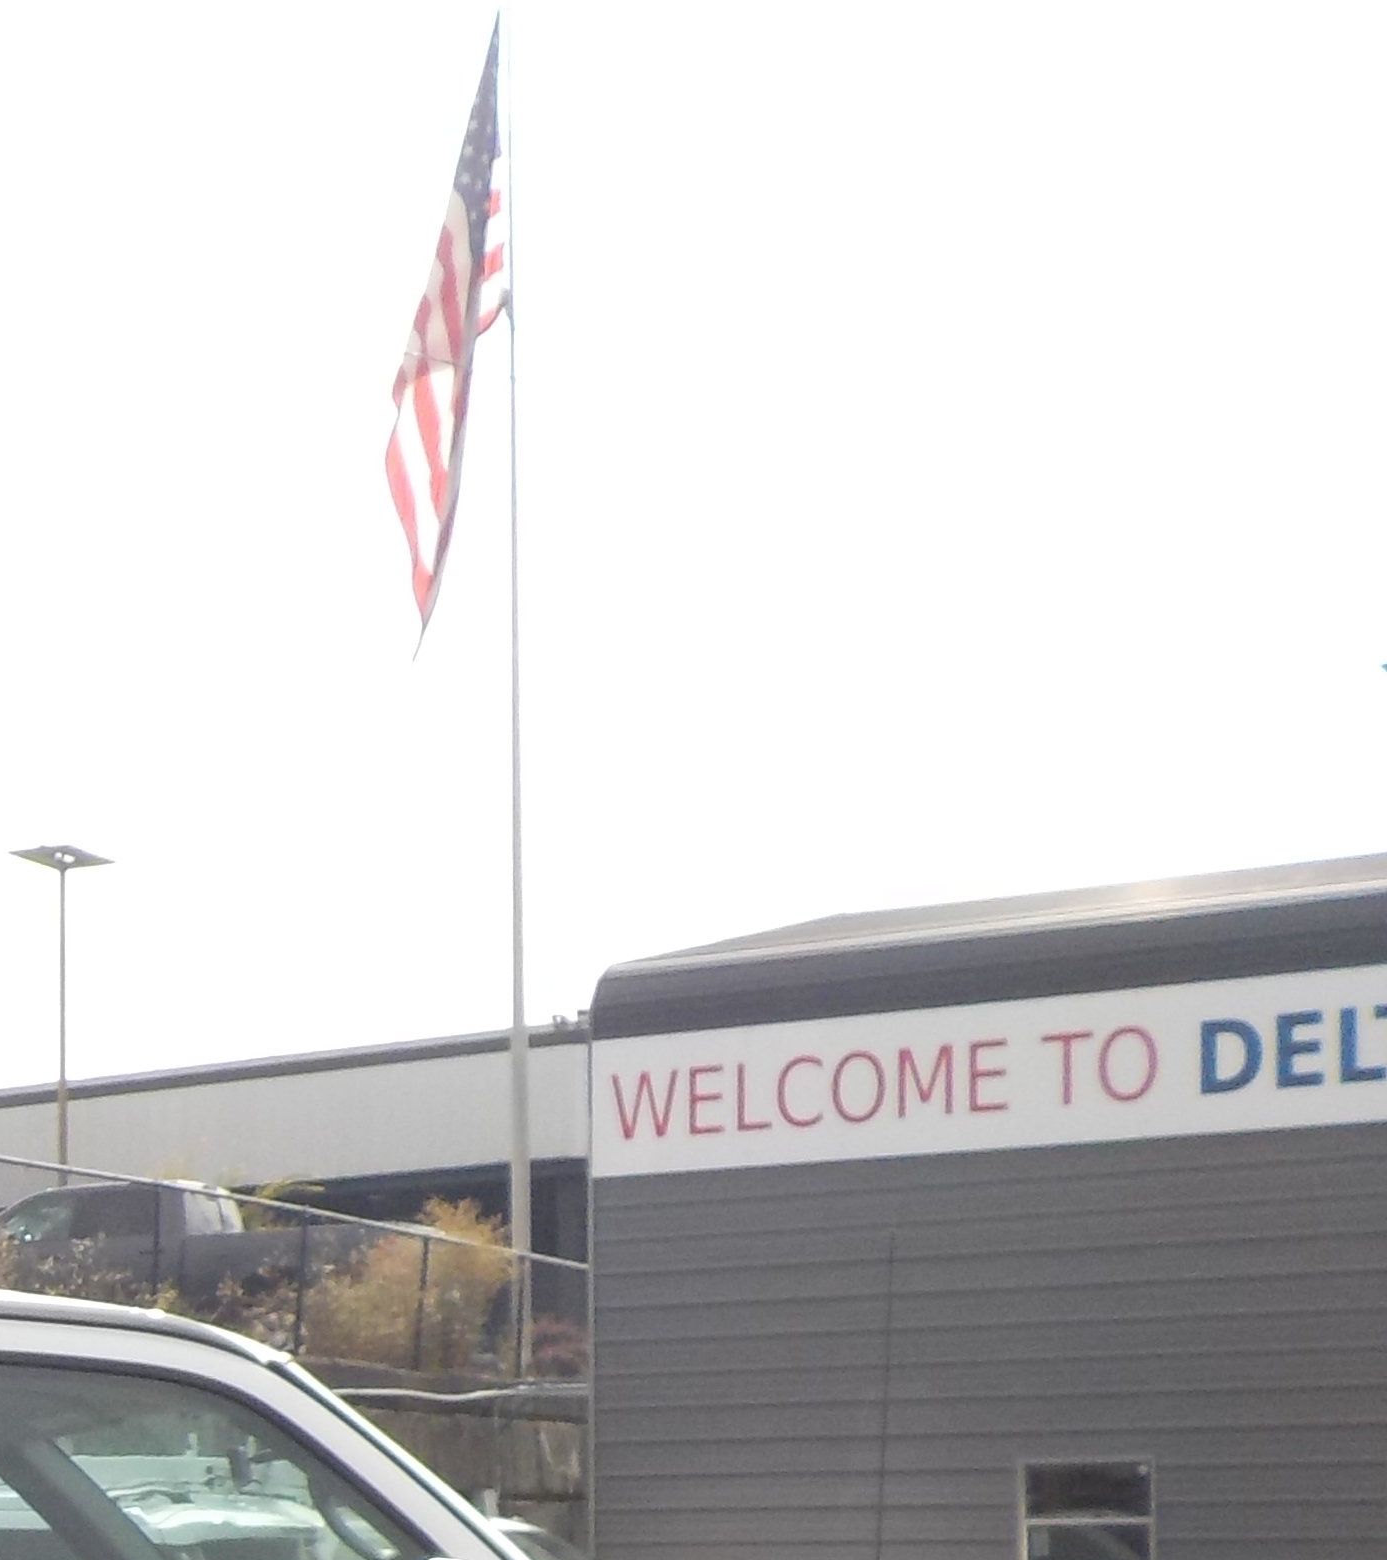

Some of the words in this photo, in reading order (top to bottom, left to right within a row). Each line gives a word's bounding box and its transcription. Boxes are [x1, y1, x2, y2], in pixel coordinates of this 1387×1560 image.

[611, 1037, 1008, 1140] WELCOME
[1040, 1026, 1158, 1105] TO
[1200, 1003, 1387, 1094] DEL
